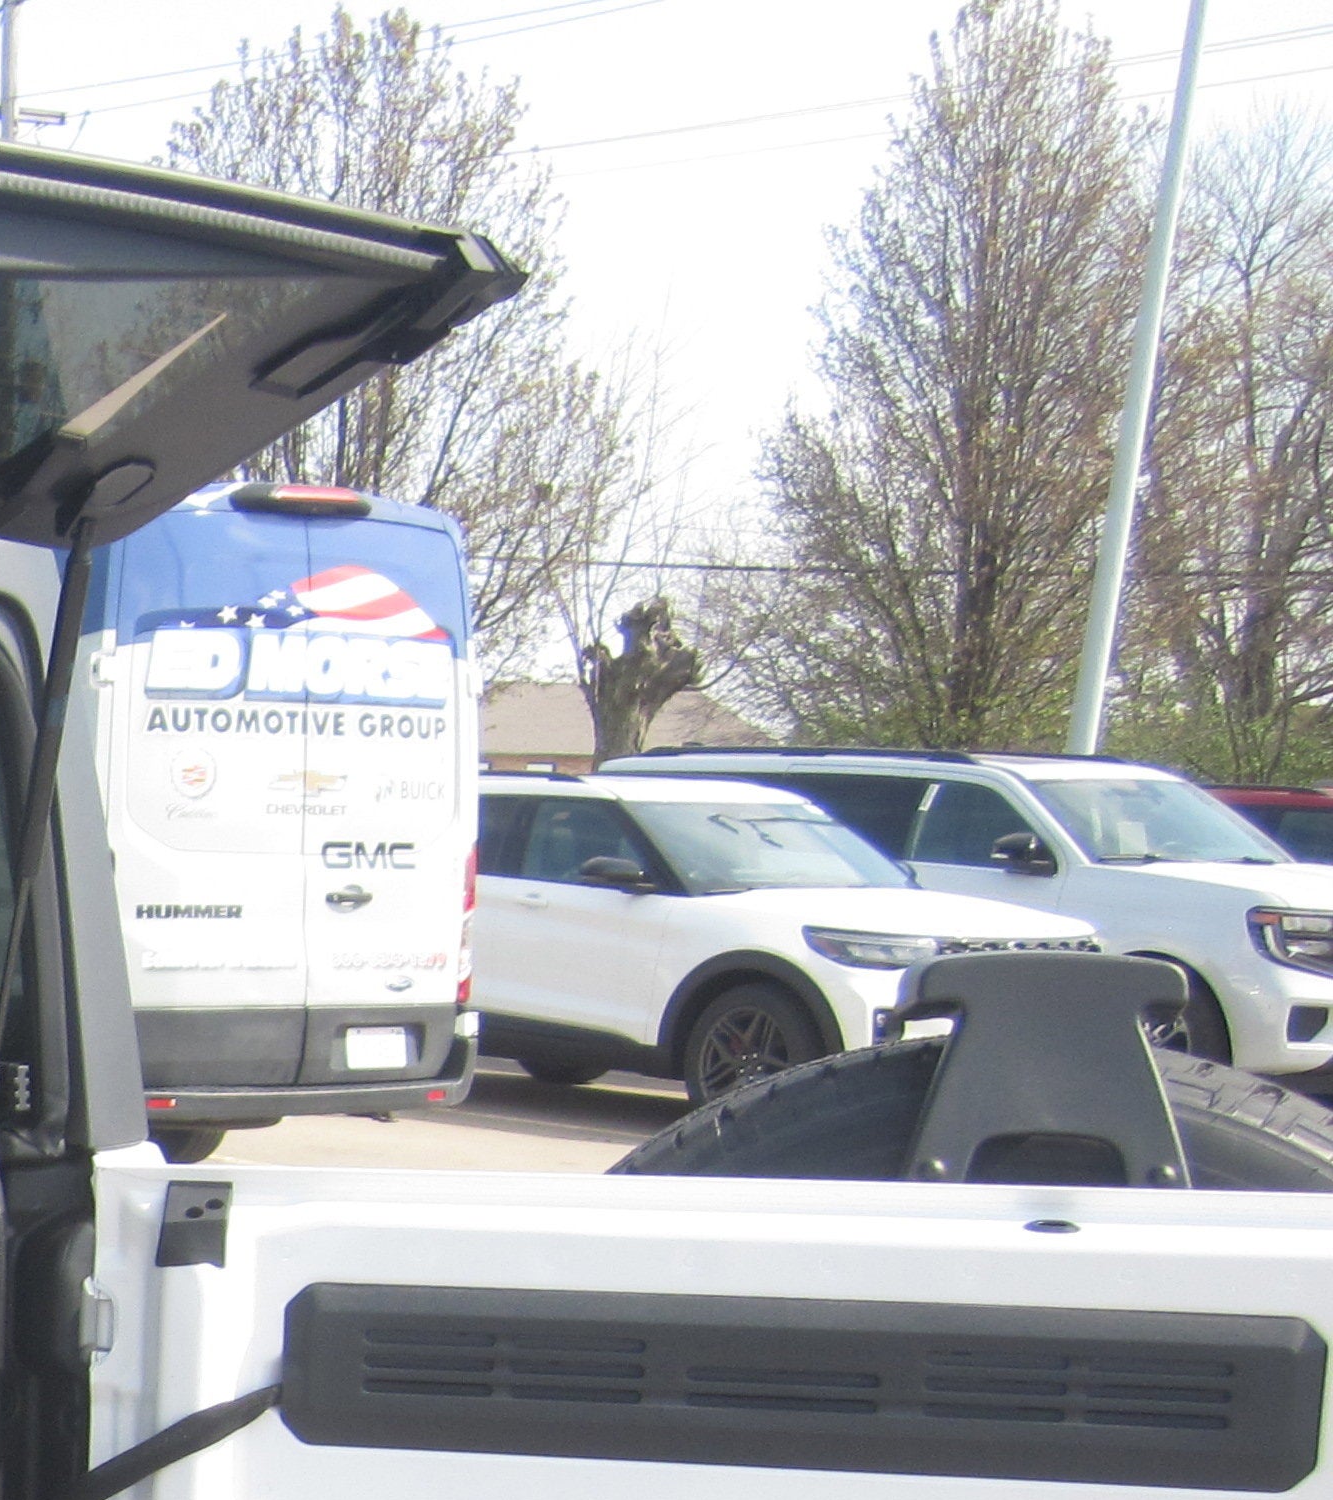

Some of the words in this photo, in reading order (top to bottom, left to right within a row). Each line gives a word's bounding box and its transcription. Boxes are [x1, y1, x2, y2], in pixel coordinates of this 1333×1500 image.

[144, 627, 247, 699] ED
[244, 630, 452, 706] MORSE
[146, 707, 346, 736] AUTOMOTIVE
[358, 712, 447, 740] GROUP
[400, 781, 446, 801] BUICK
[265, 804, 348, 817] CHEVROLET
[321, 841, 416, 870] GMC
[135, 904, 244, 920] HUMMER
